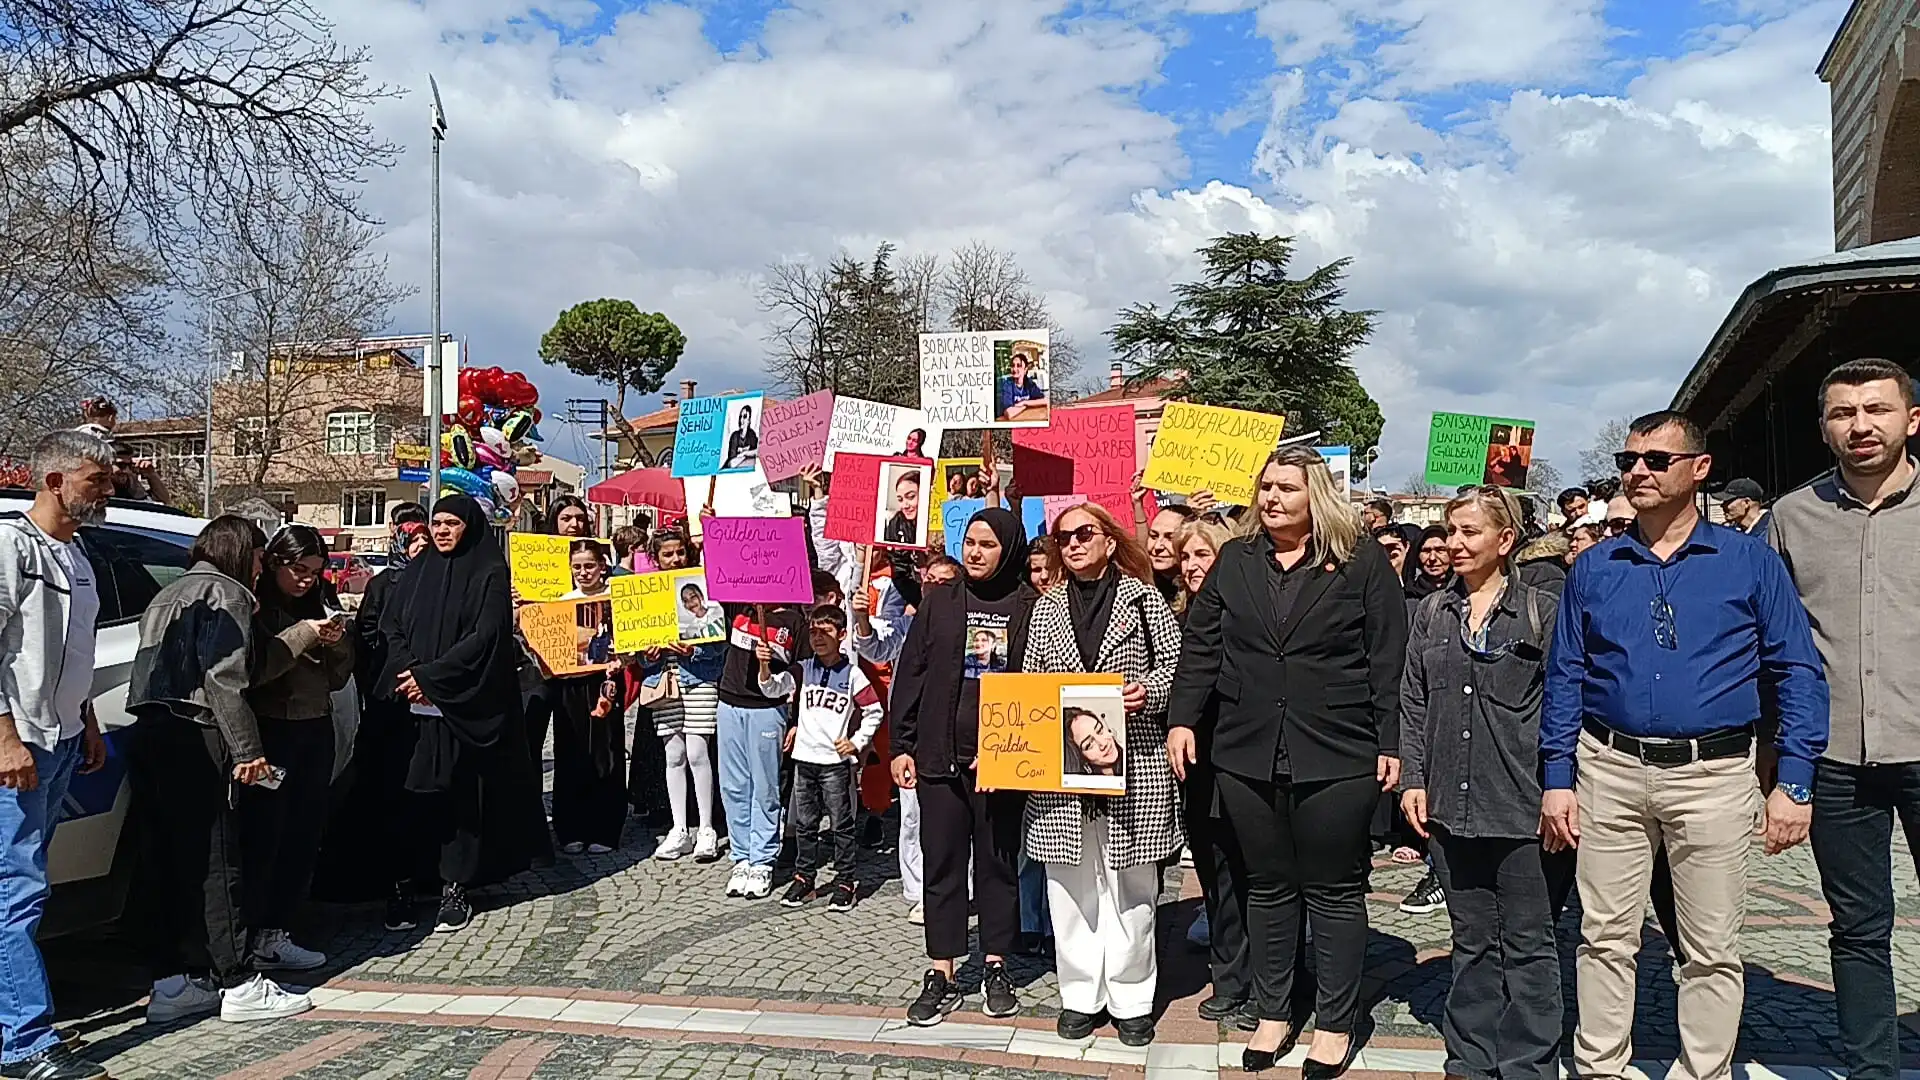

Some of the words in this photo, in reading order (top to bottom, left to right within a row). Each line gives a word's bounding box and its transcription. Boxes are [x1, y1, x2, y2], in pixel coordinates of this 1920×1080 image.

[922, 355, 948, 371] CAN
[941, 389, 953, 404] 5
[956, 388, 980, 405] YIL
[836, 399, 861, 416] KISA
[1430, 461, 1480, 479] UNUTMA!
[1154, 471, 1203, 489] ADALET
[611, 574, 670, 599] GÜLDEN
[521, 605, 544, 619] KISA
[805, 689, 849, 714] H723
[982, 732, 1042, 762] Gülden
